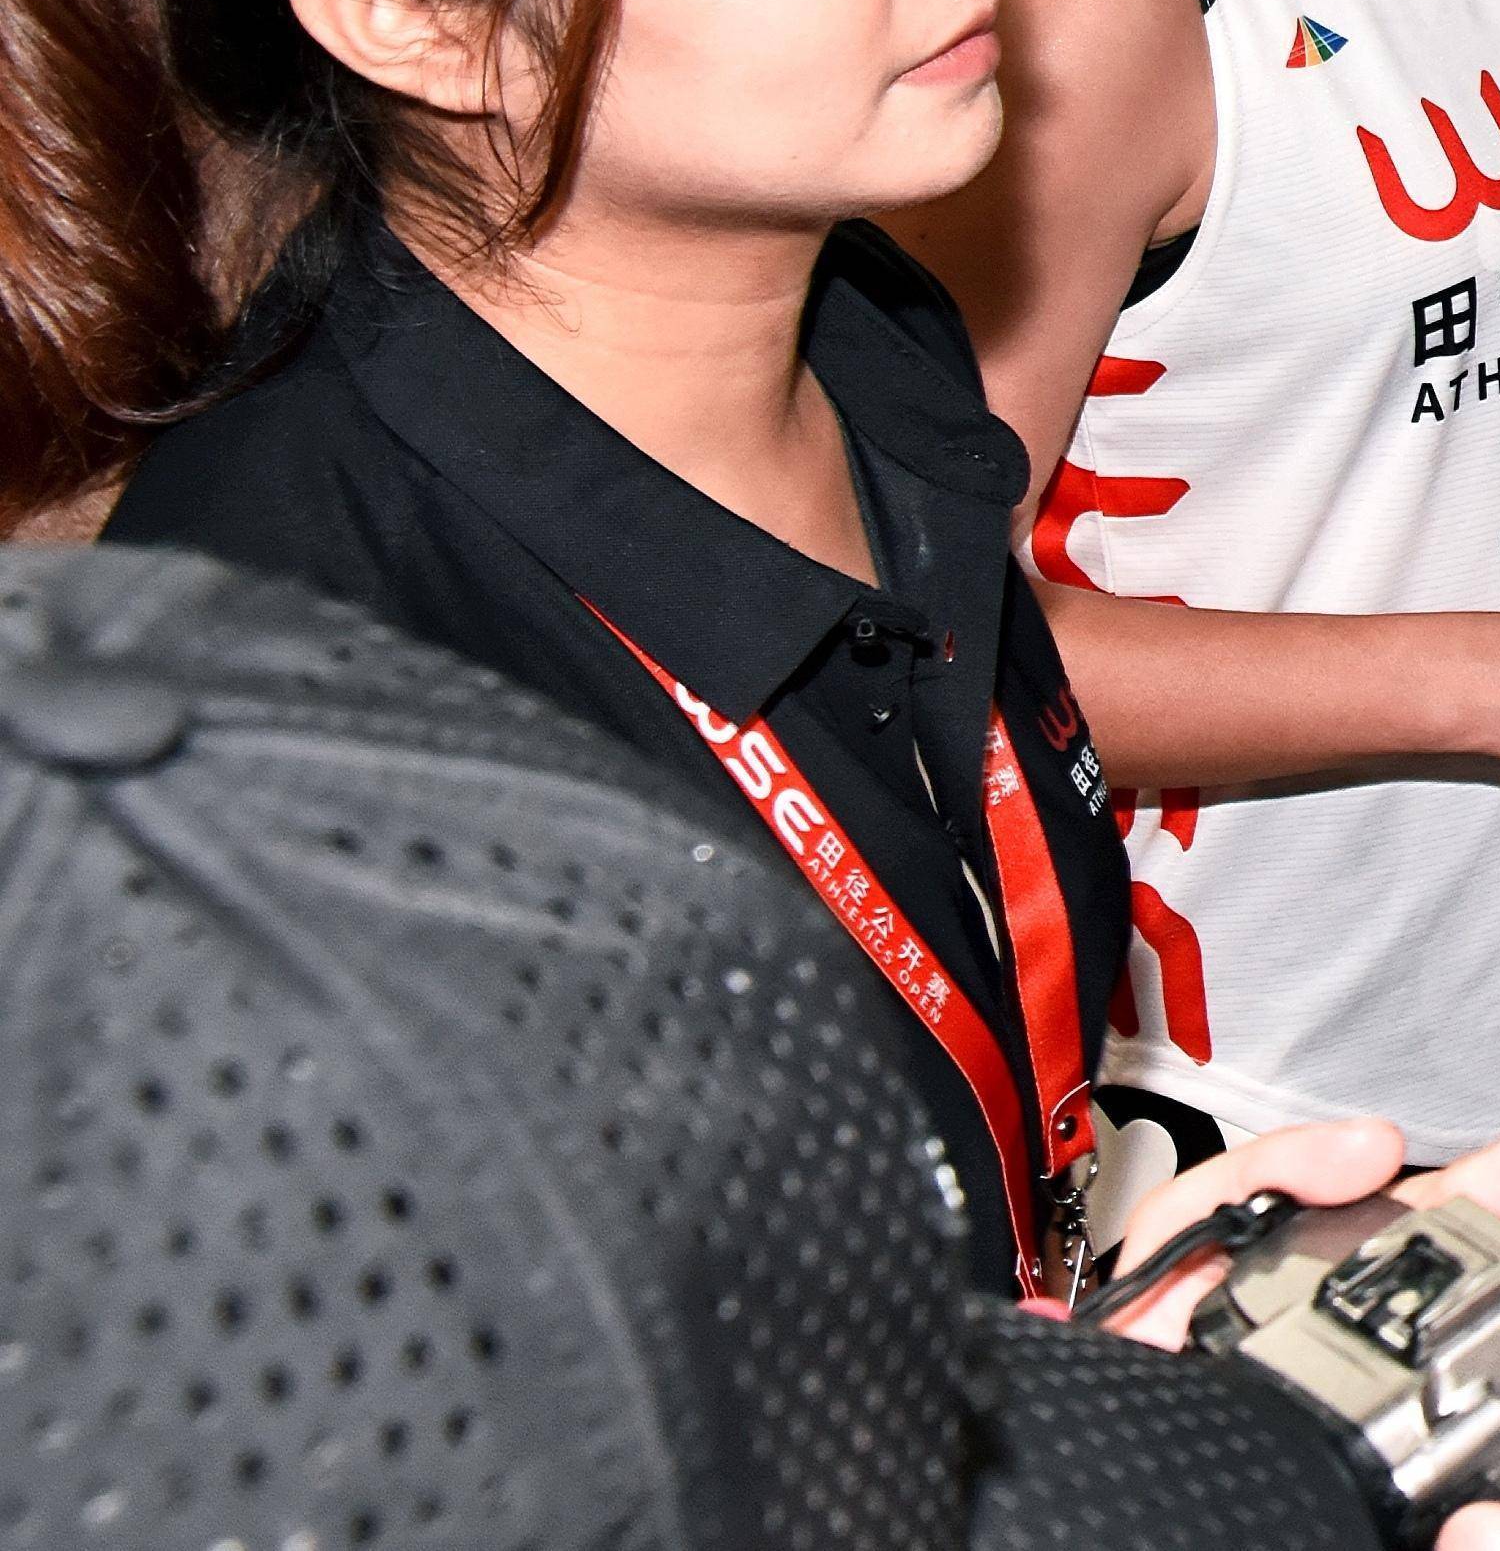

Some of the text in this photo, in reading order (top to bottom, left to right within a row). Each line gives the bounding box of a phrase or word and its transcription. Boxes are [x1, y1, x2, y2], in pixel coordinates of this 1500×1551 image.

[807, 858, 942, 1024] ATHLETICS OPEN
[816, 831, 951, 1008] 田径公开赛
